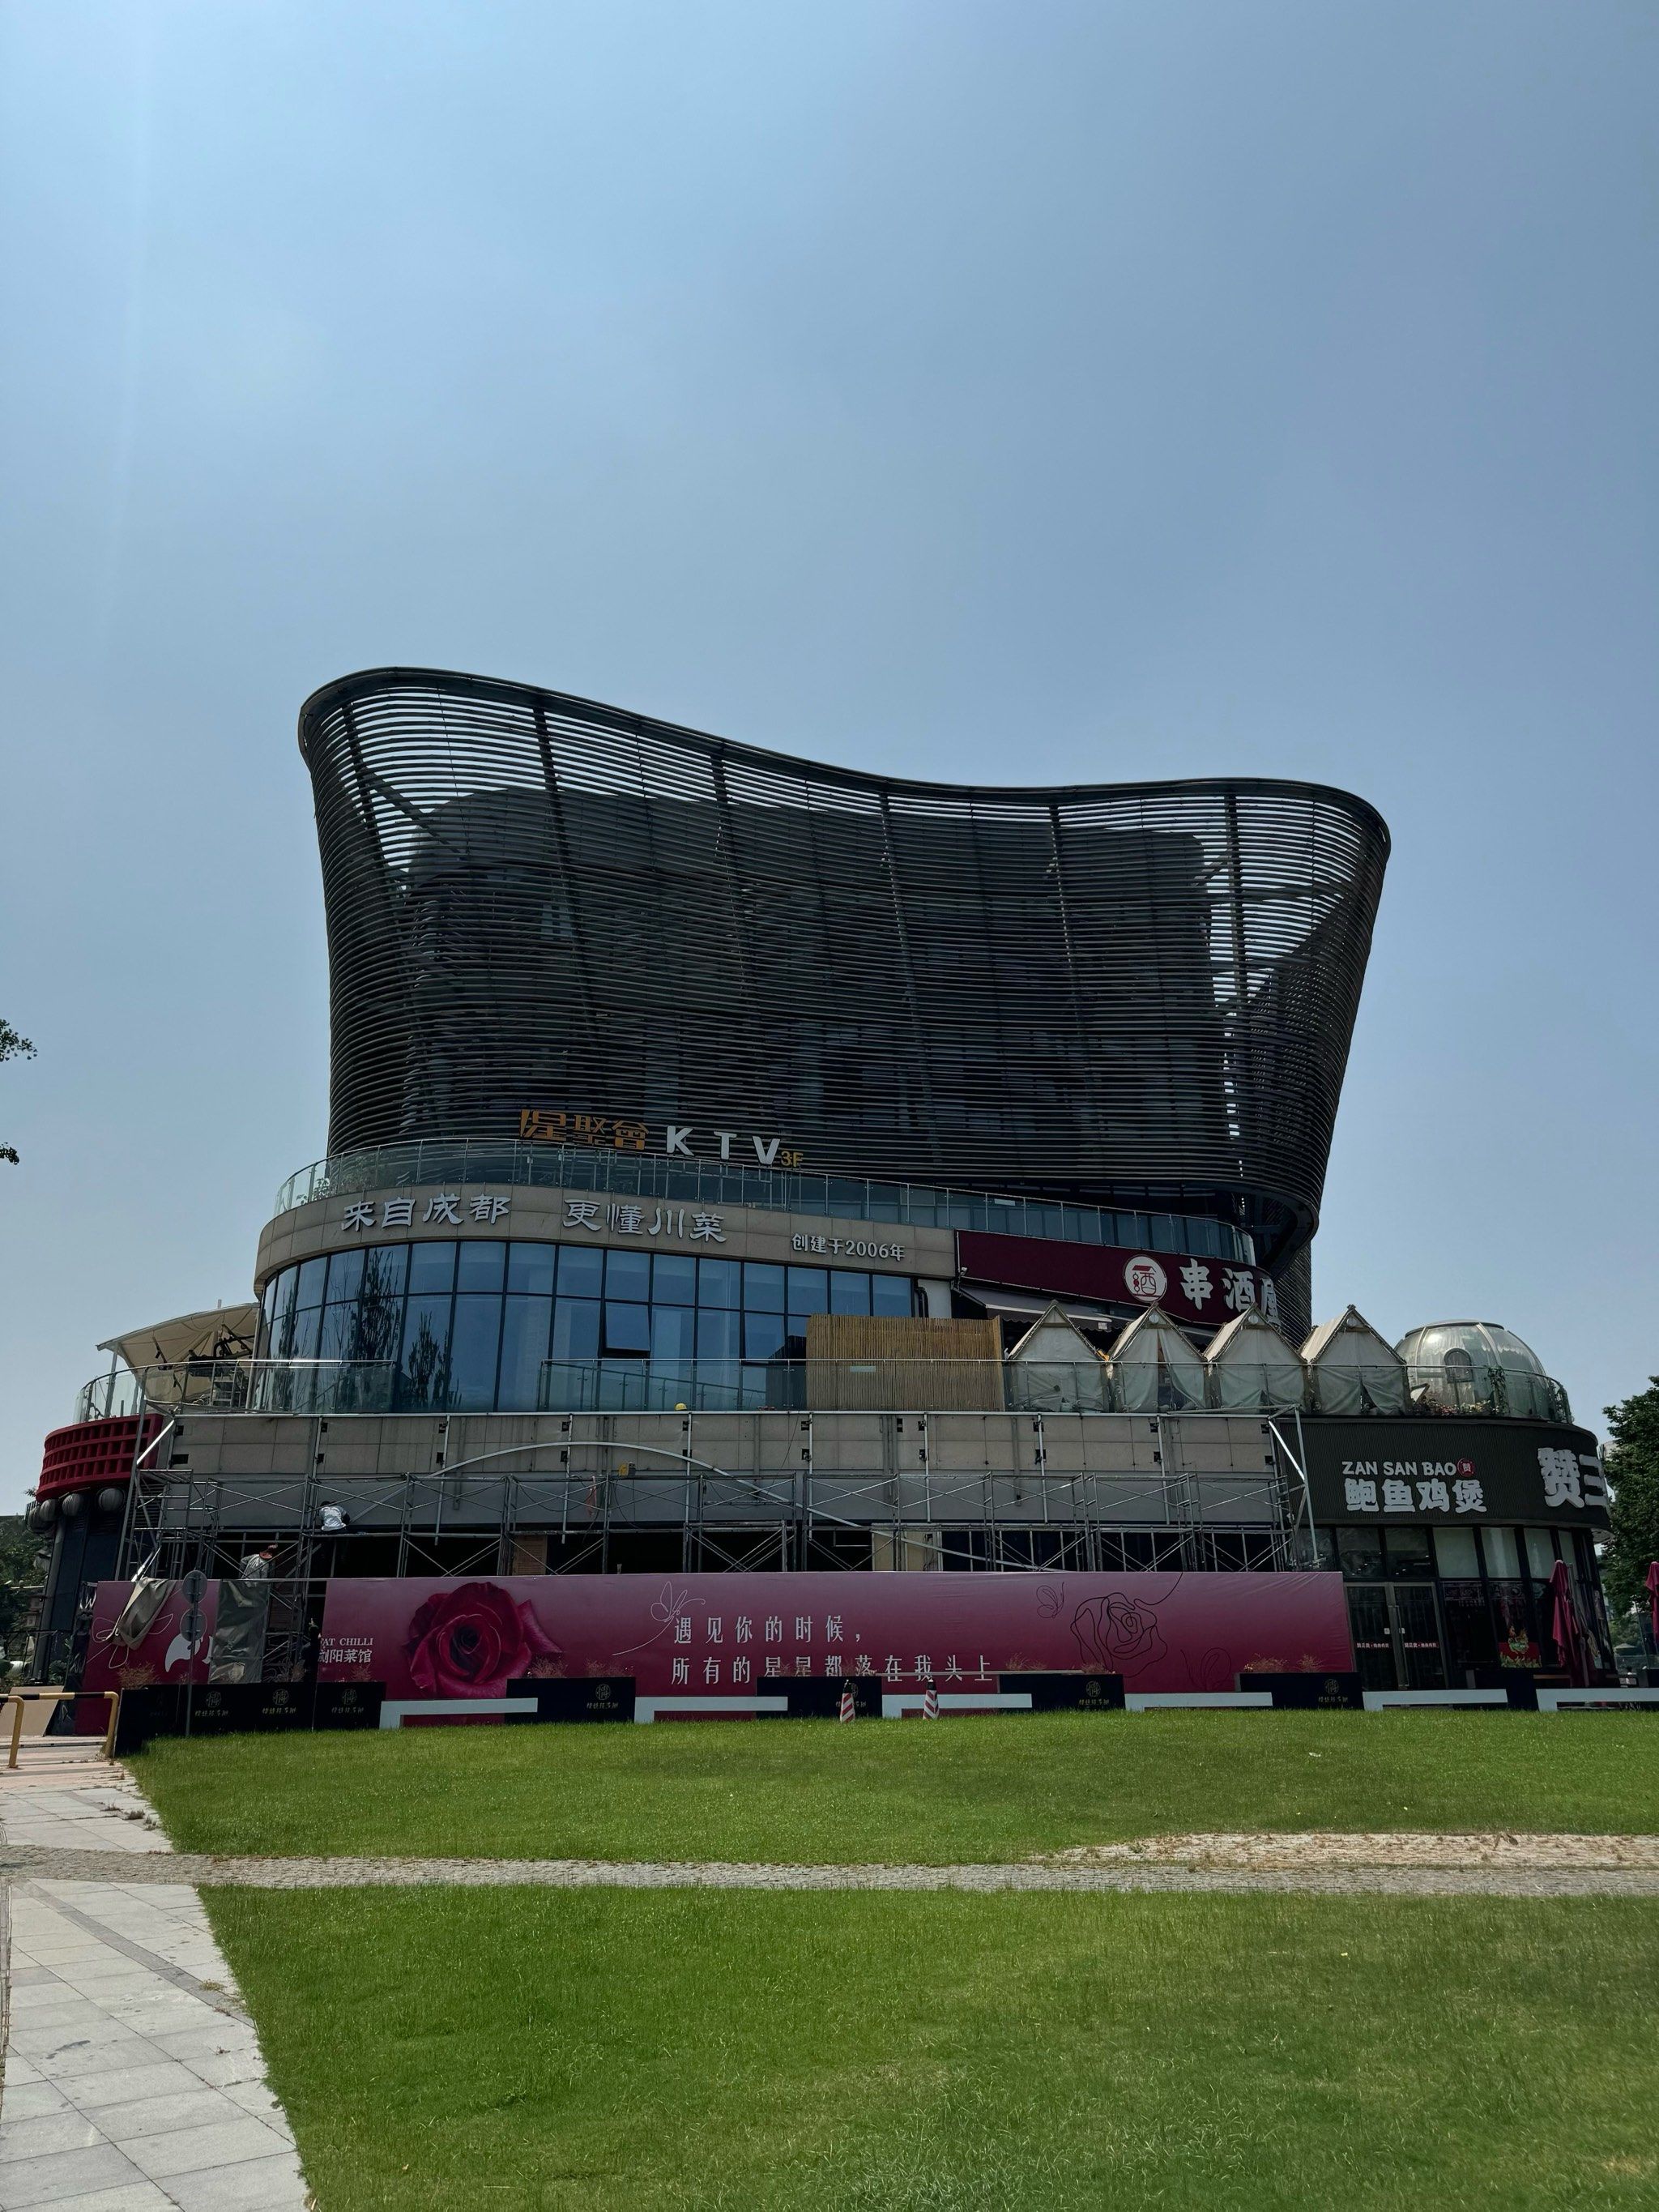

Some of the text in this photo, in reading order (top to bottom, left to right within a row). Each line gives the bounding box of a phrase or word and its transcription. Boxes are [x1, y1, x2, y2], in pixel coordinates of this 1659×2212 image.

[666, 1125, 780, 1164] KTV
[781, 1151, 804, 1168] 3F
[340, 1192, 727, 1242] 来自成都 更懂川菜
[791, 1233, 906, 1262] 创建于2006年
[1341, 1461, 1456, 1476] ZAN SAN BAO
[1344, 1478, 1487, 1514] 鲍鱼鸡煲
[339, 1638, 373, 1646] CHILLI
[671, 1655, 993, 1685] 所有的星星都落在我头上
